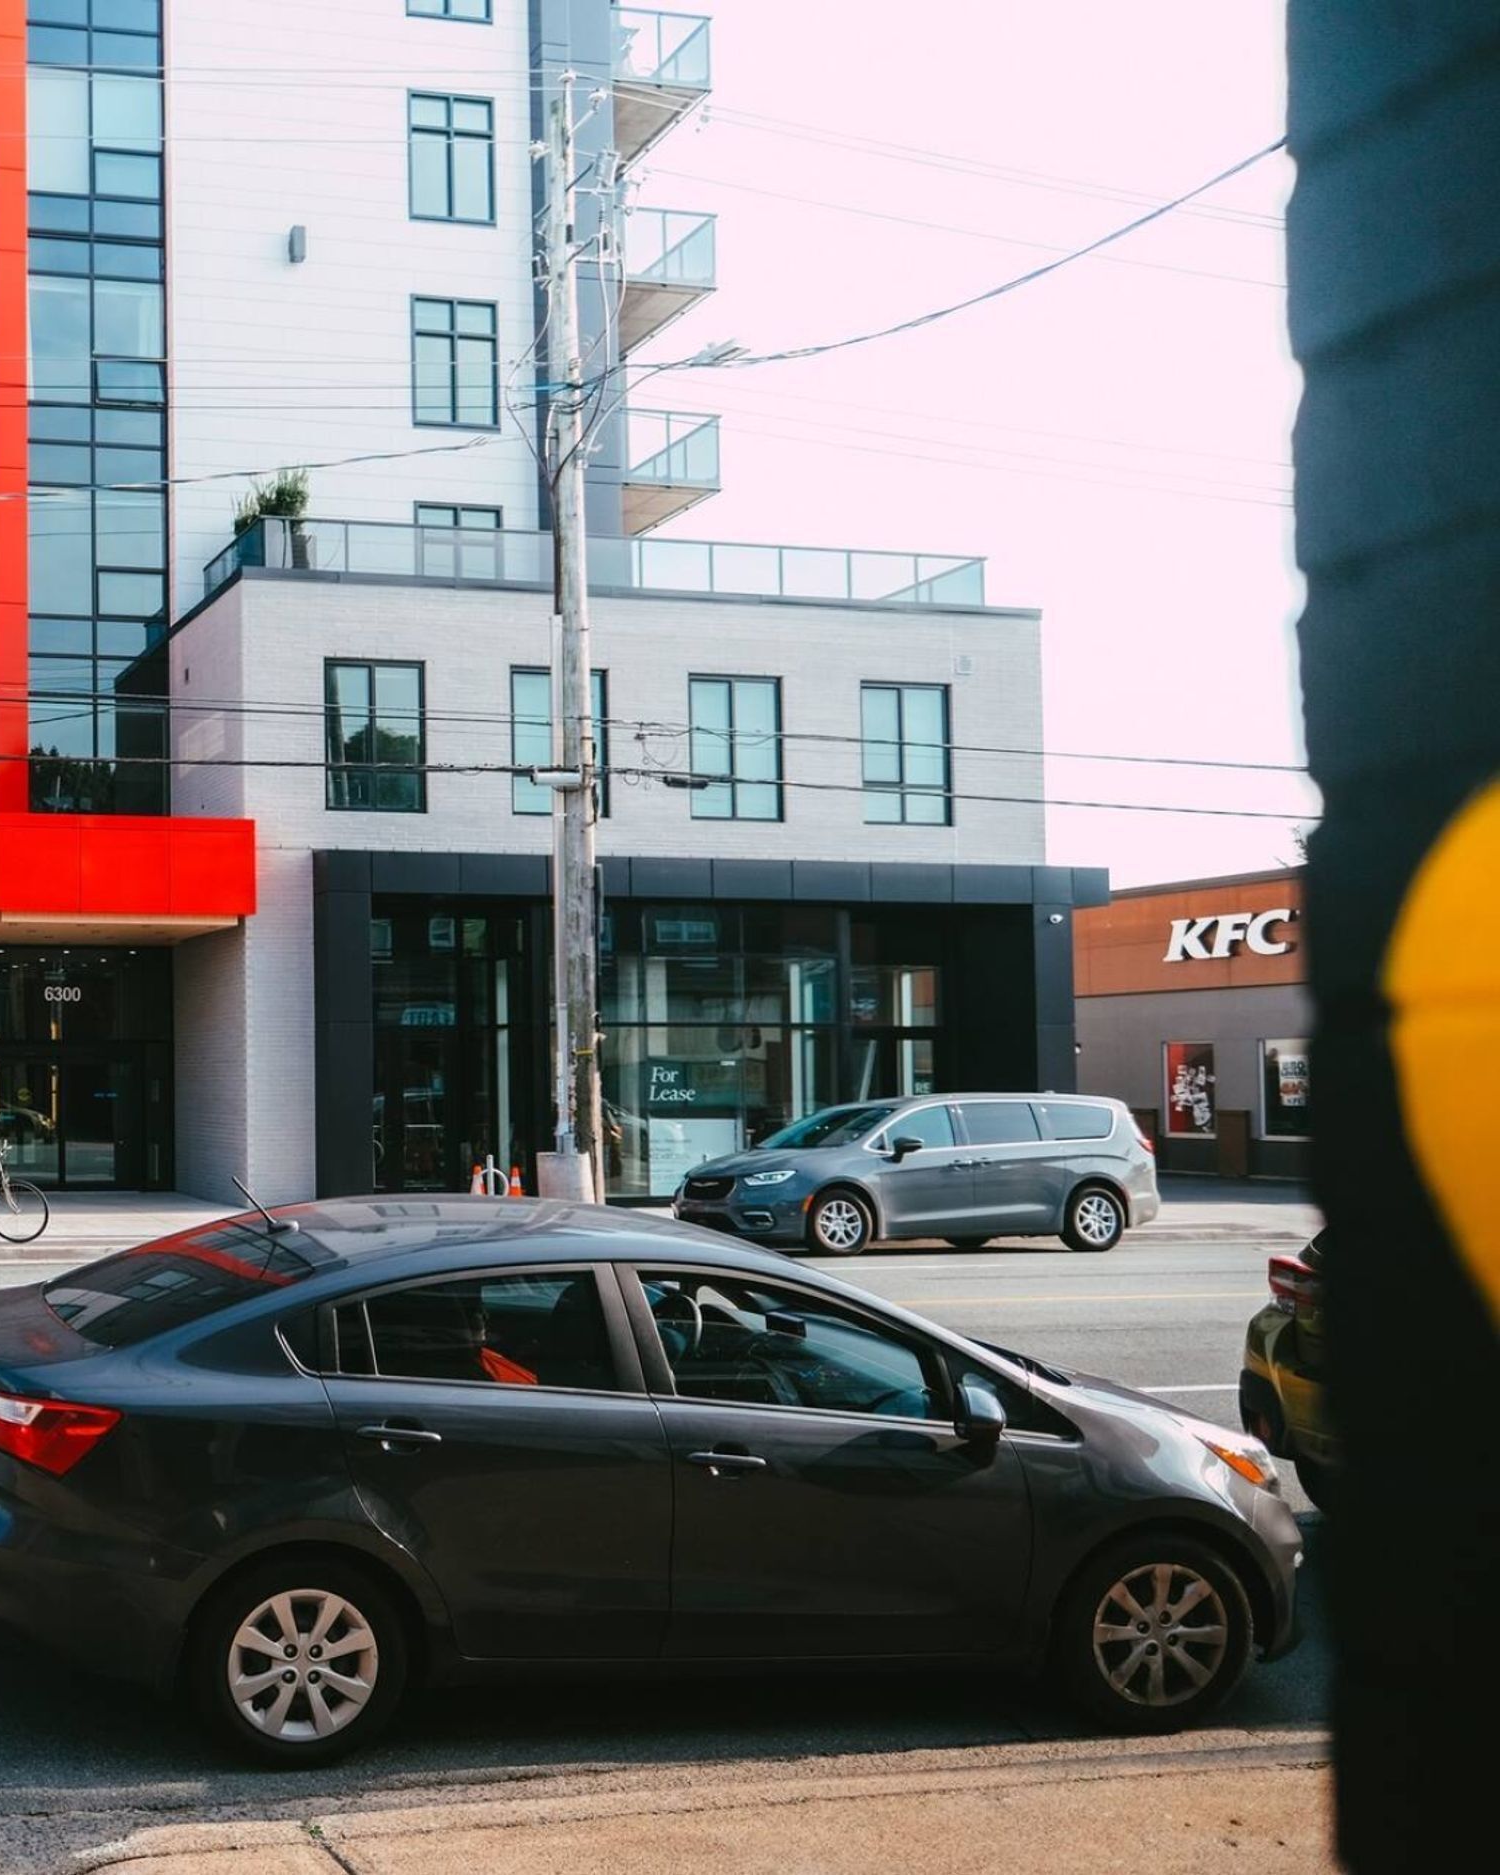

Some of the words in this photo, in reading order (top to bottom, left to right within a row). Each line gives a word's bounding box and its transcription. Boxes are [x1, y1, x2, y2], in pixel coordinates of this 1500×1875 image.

[1162, 908, 1291, 962] KFC
[44, 986, 81, 1001] 6300
[651, 1066, 679, 1082] For
[649, 1084, 696, 1101] Lease
